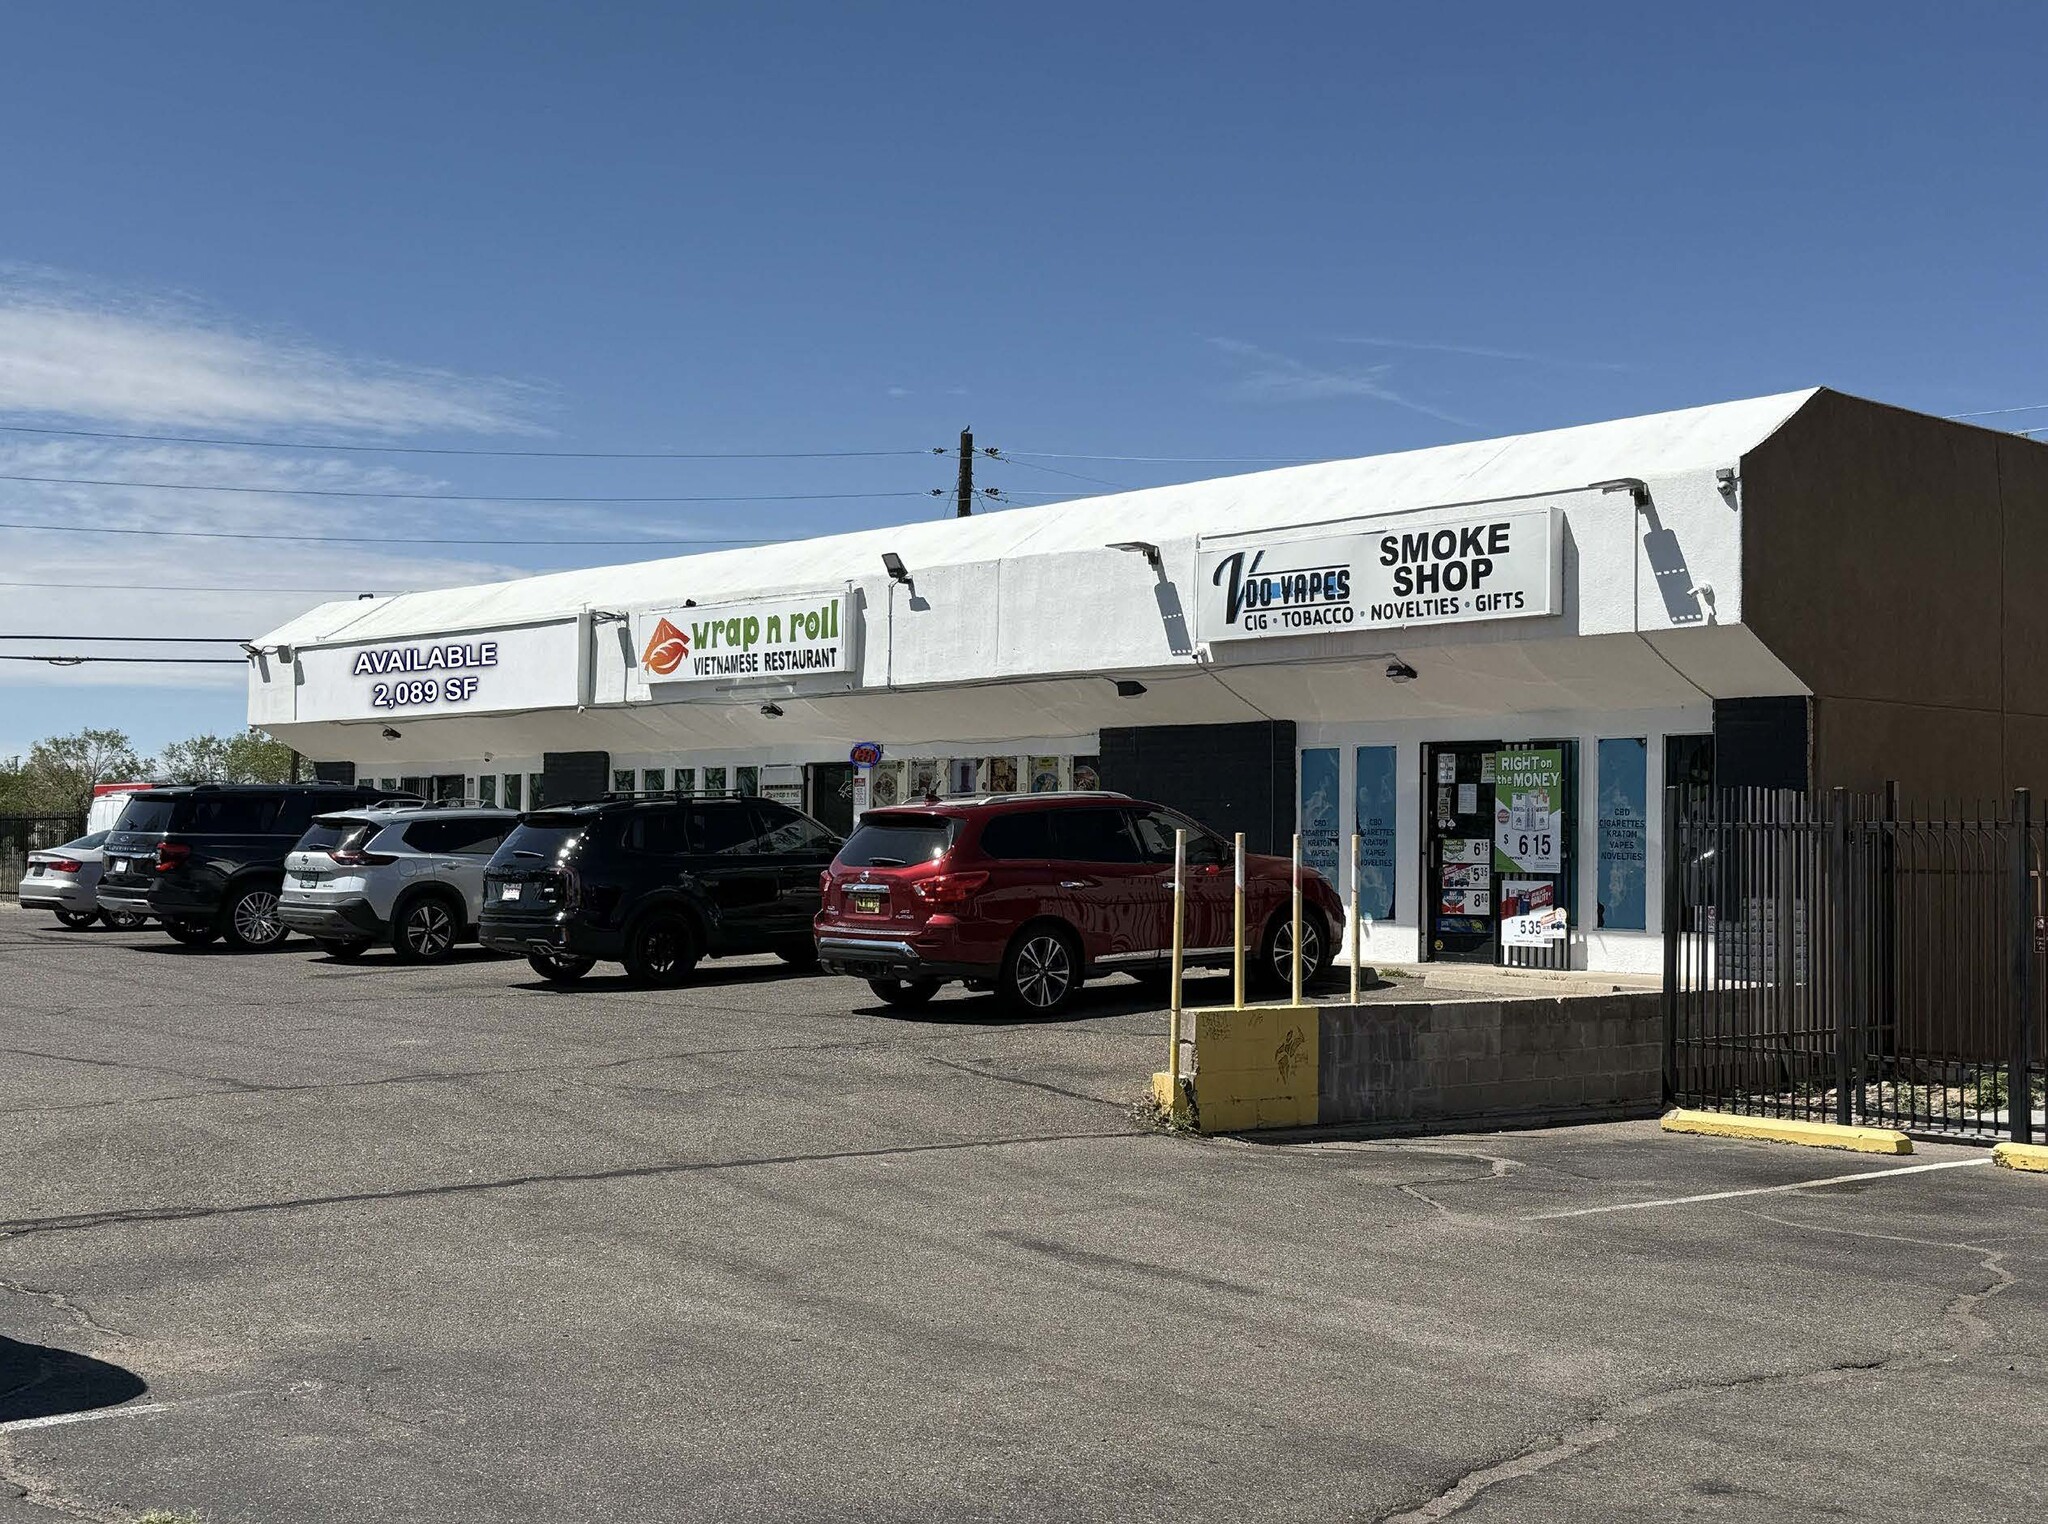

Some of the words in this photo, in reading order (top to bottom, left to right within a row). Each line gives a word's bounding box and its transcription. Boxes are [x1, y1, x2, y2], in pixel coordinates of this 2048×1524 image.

[1379, 522, 1511, 567] SMOKE
[1281, 569, 1350, 604] VAPES
[1392, 558, 1493, 597] SHOP
[691, 615, 760, 652] wrap
[766, 615, 782, 644] n
[789, 599, 839, 643] roll
[1244, 614, 1268, 631] CIG
[1281, 606, 1354, 628] TOBACCO
[1370, 597, 1460, 621] NOVELTIES
[1475, 591, 1525, 612] GIFTS
[353, 642, 498, 676] AVAILABLE
[693, 653, 759, 676] VIETNAMESE
[764, 647, 837, 672] RESTAURANT
[372, 680, 438, 710] 2,089
[445, 676, 479, 701] SF
[1501, 756, 1540, 771] RIGHT
[1540, 758, 1552, 769] on
[1497, 774, 1512, 785] the
[1513, 772, 1560, 787] MONEY
[1599, 819, 1646, 828] CIGARETTES
[1614, 808, 1630, 816] CBD
[1600, 852, 1643, 860] NOVELTIES
[1610, 841, 1634, 849] VAPES
